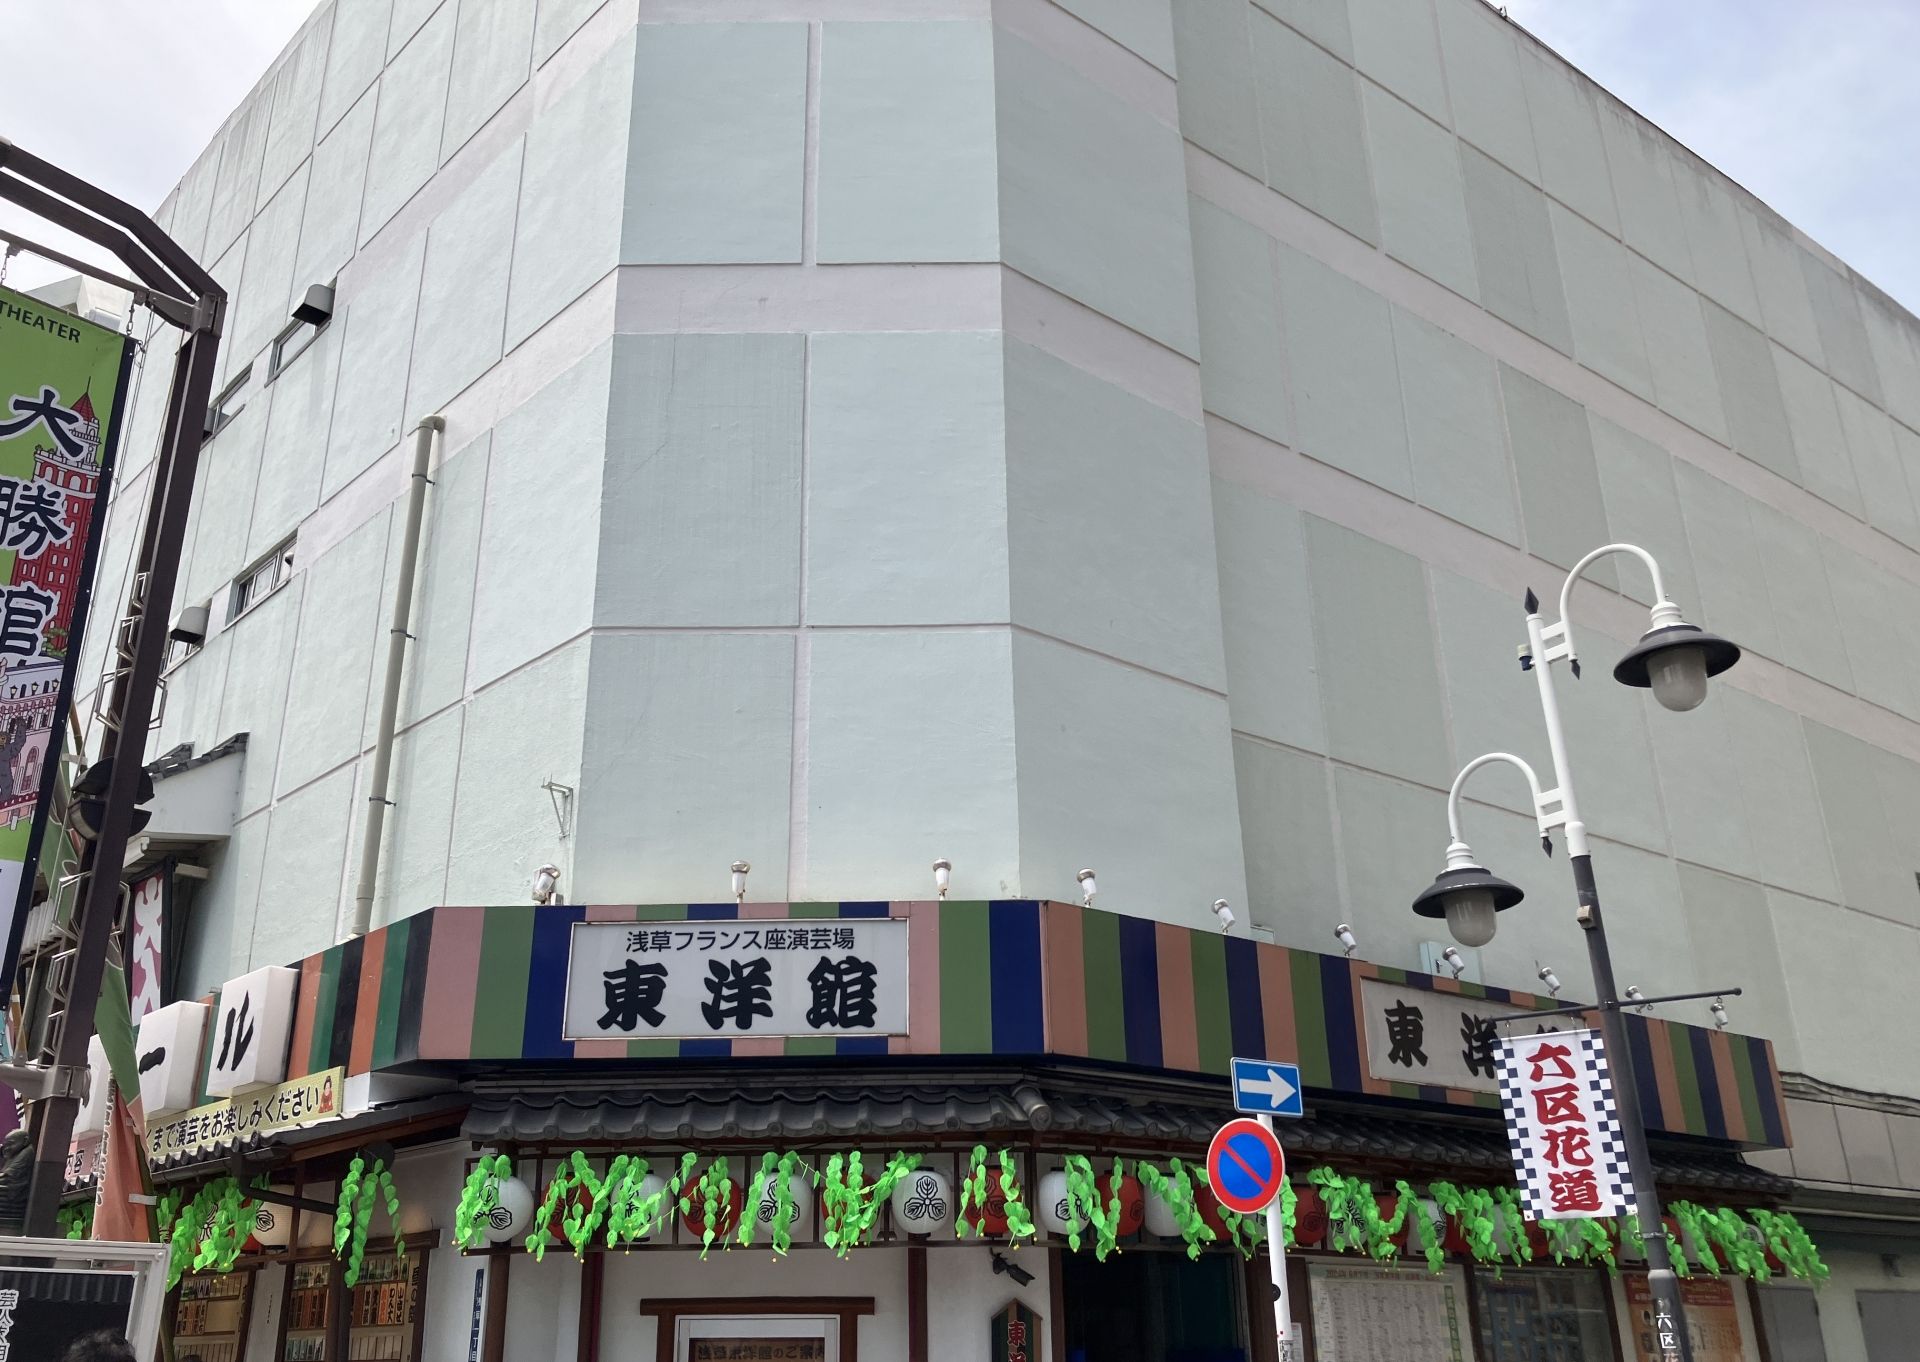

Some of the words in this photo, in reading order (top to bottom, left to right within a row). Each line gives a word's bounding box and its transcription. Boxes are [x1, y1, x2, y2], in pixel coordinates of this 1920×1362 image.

[625, 928, 855, 953] 浅草フランス座演芸場
[596, 956, 878, 1032] 東洋館
[1385, 999, 1562, 1079] 東洋
[1526, 1042, 1603, 1213] 六区花道
